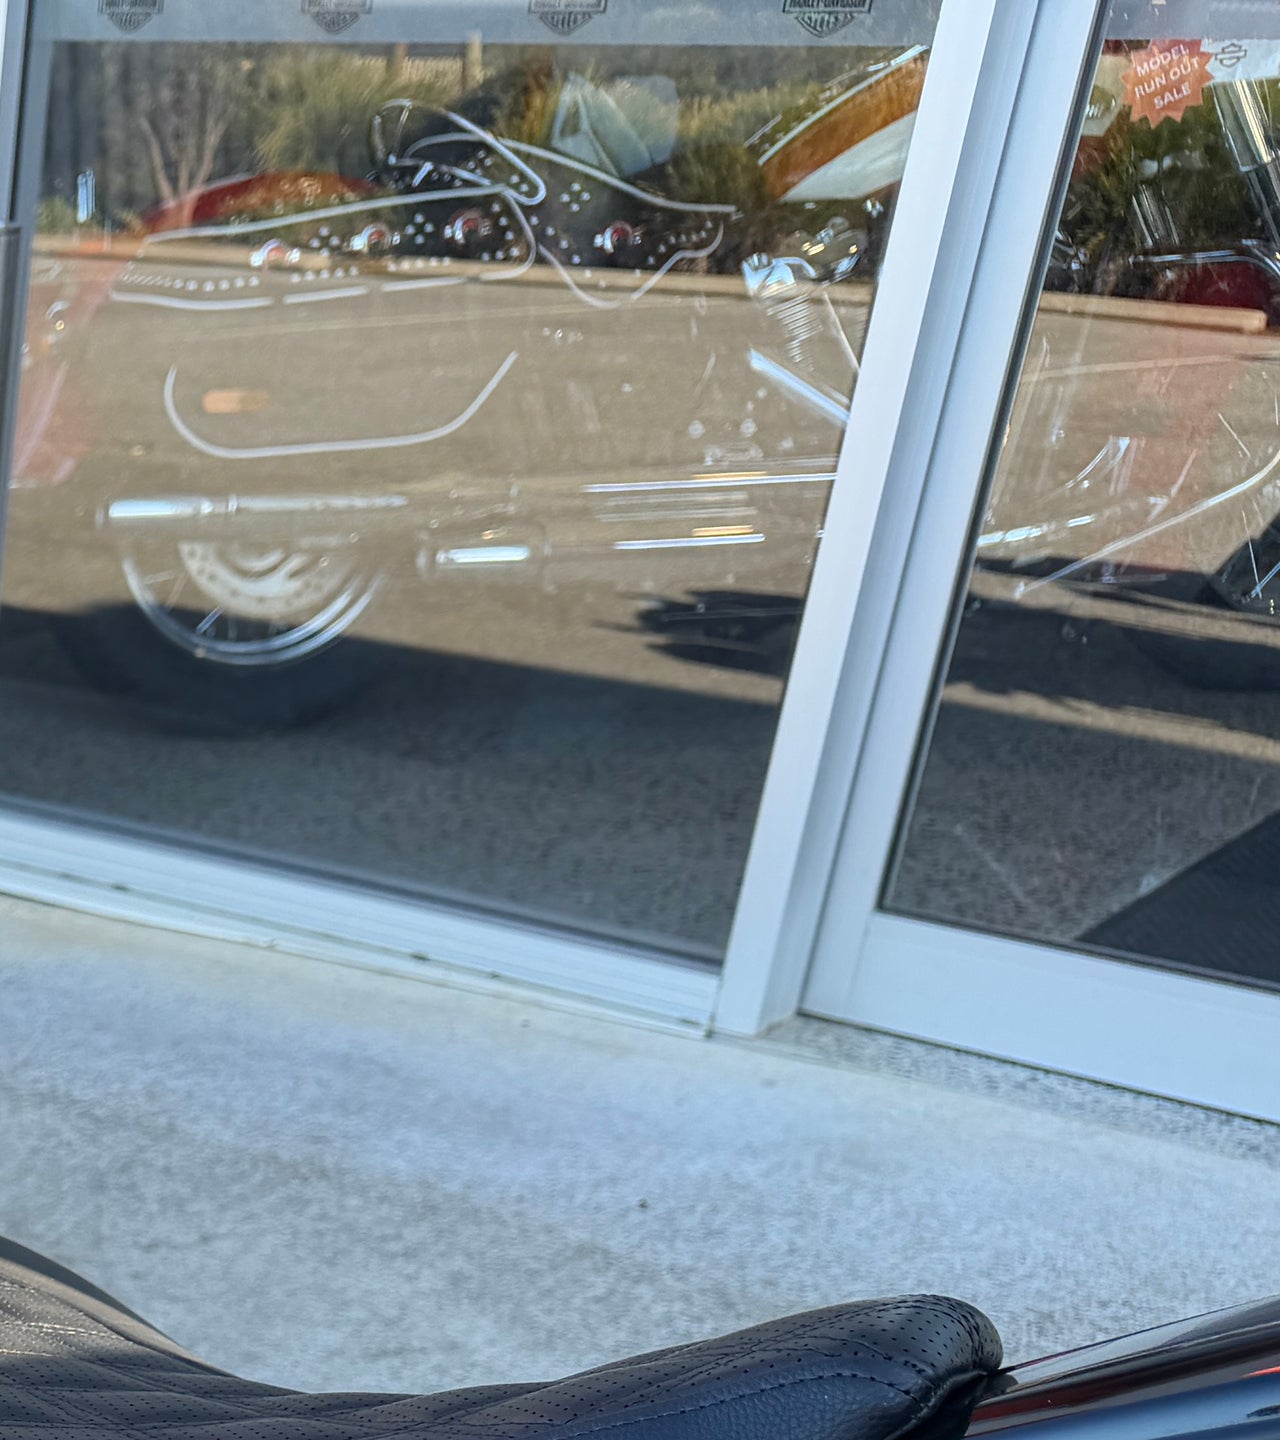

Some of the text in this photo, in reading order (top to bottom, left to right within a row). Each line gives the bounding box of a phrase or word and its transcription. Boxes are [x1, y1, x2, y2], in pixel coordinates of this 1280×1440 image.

[1136, 43, 1190, 77] MODEL
[1135, 56, 1200, 99] RUN OUT
[1154, 82, 1192, 109] SALE
